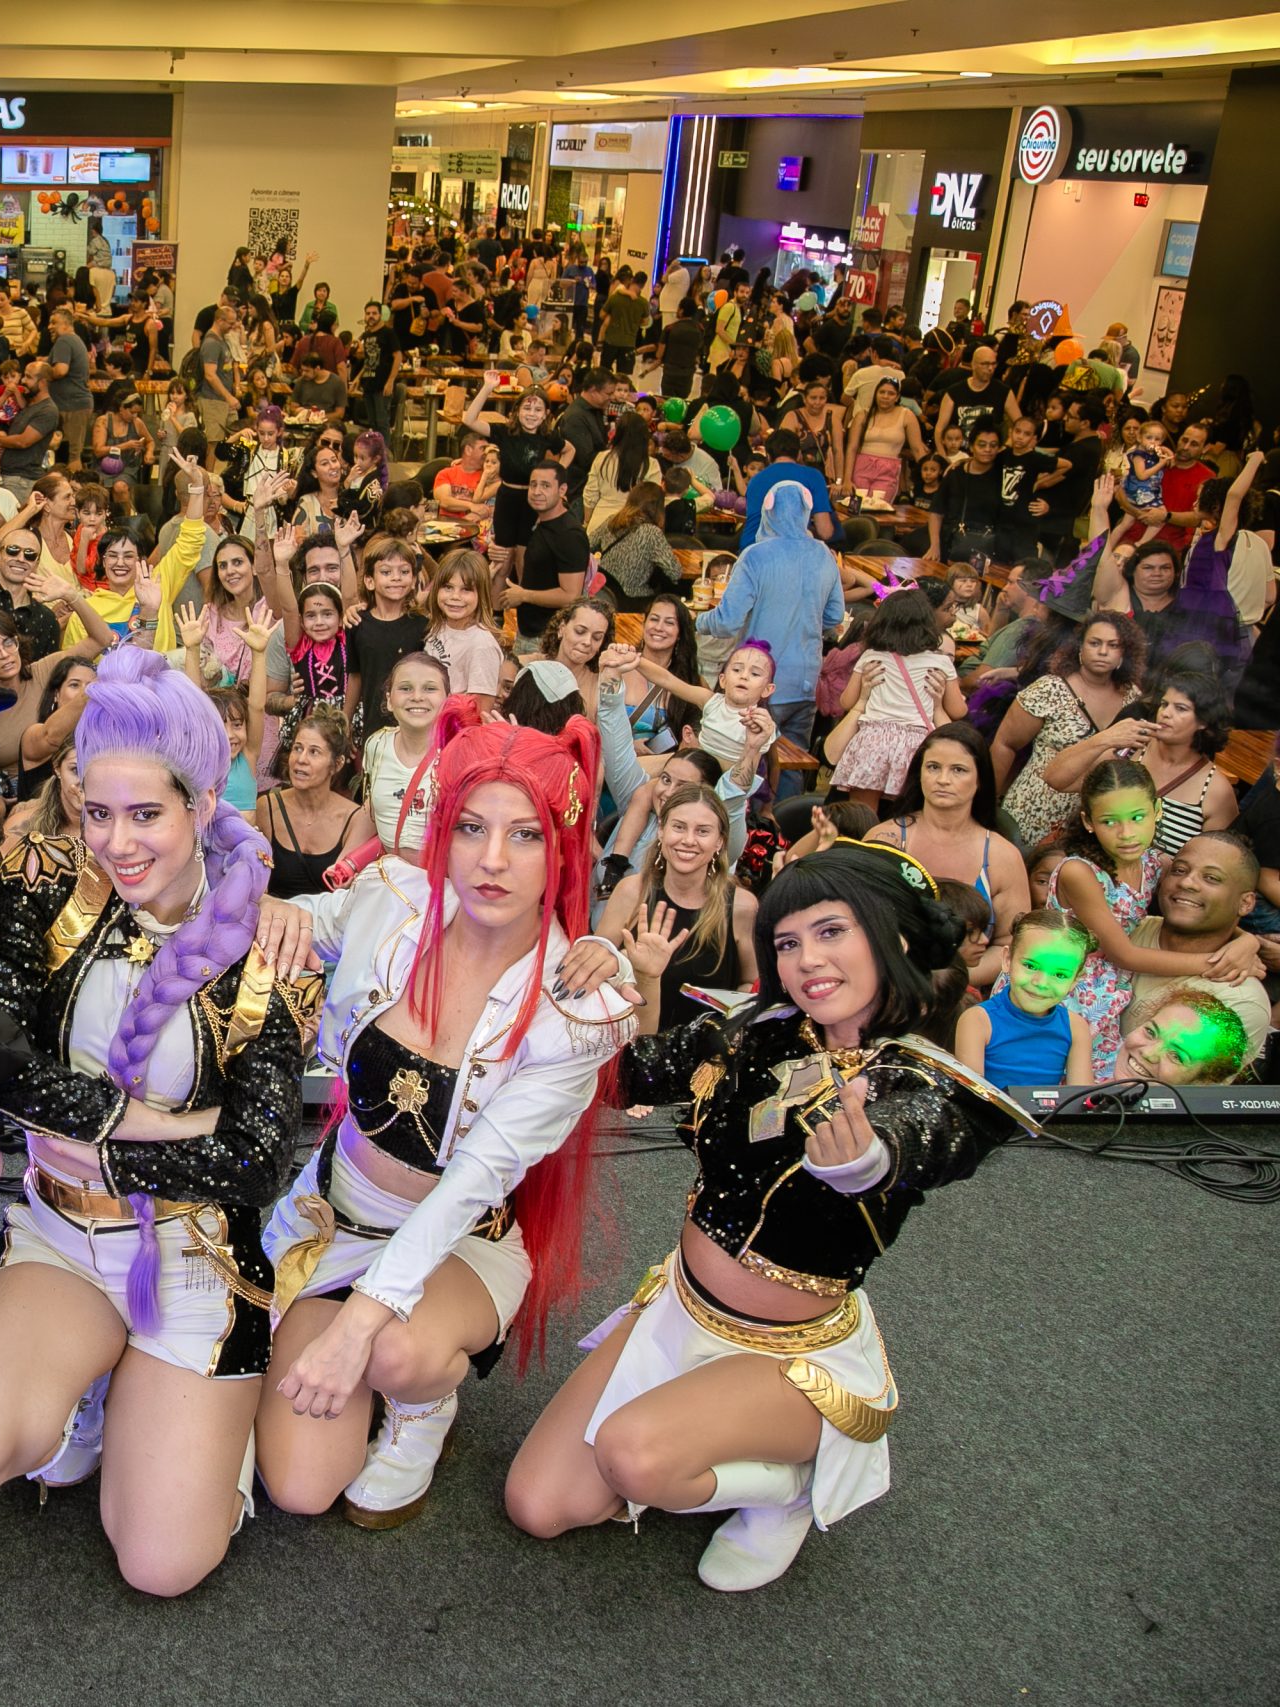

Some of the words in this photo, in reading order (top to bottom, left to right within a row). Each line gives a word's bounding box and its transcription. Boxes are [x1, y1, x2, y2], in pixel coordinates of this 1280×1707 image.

[1076, 148, 1110, 172] seu
[1110, 143, 1188, 174] sorvete
[500, 183, 530, 211] RCHLO
[930, 172, 983, 228] DNZ
[855, 216, 880, 230] BLACK
[951, 217, 976, 231] óticas
[852, 230, 880, 243] FRIDAY
